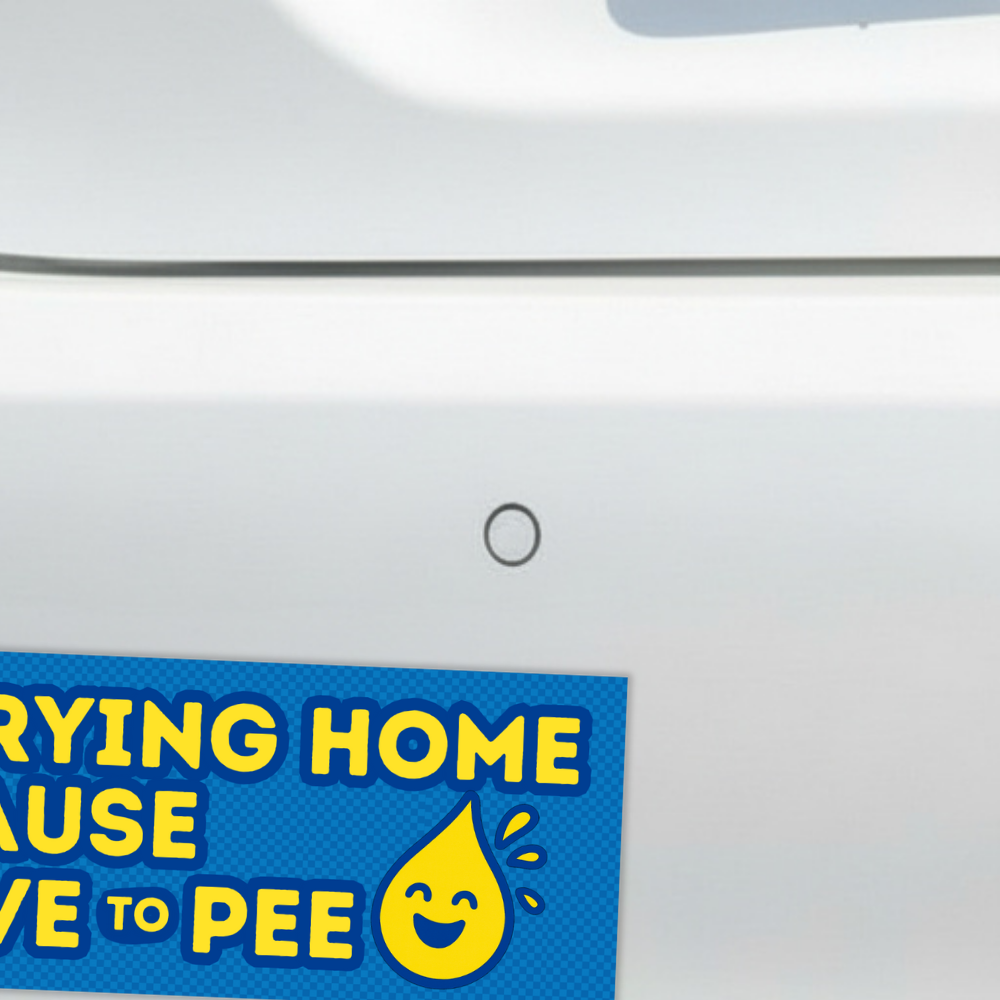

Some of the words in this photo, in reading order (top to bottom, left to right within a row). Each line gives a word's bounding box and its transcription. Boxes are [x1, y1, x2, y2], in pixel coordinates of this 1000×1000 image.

[311, 707, 581, 785] HOME
[106, 895, 170, 933] TO
[192, 886, 354, 960] PEE
